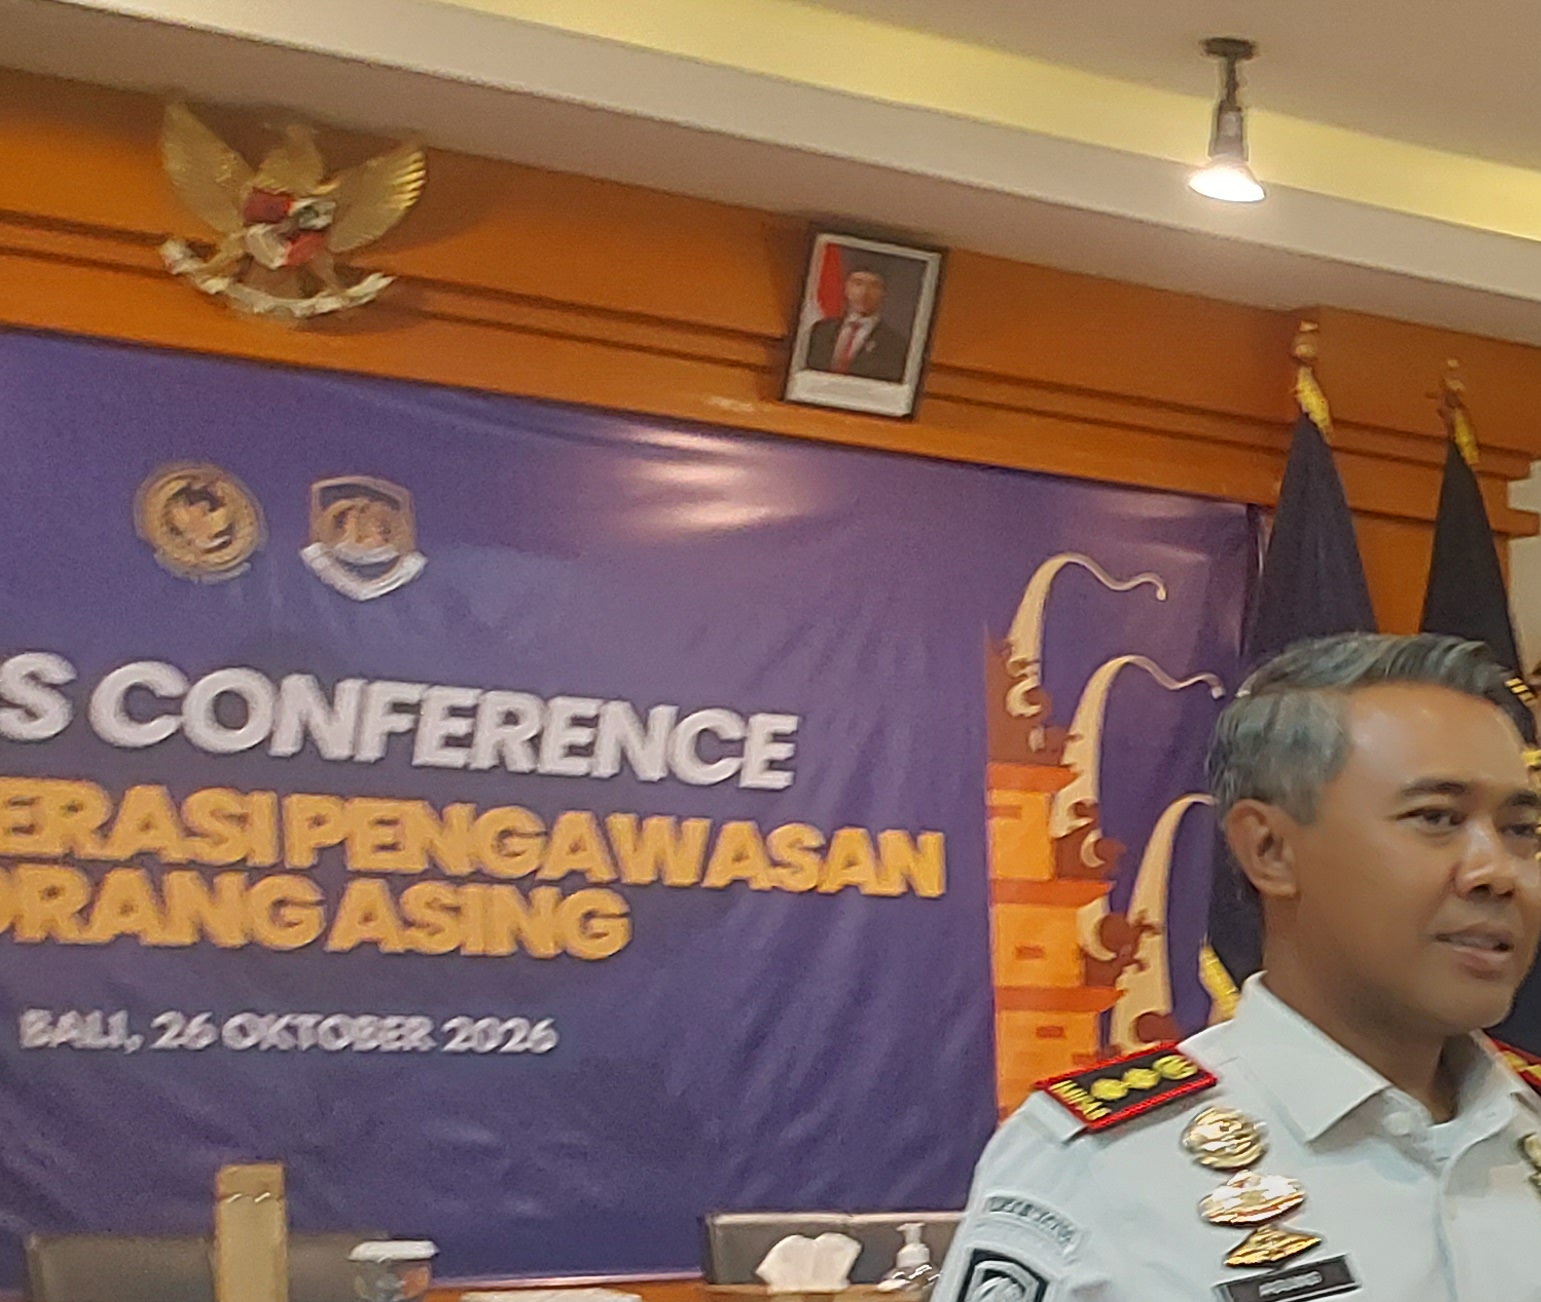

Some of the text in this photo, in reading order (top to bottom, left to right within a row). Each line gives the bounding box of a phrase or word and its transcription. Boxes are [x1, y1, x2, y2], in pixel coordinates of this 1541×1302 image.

[0, 651, 800, 790] S CONFERENCE
[283, 792, 947, 898] PENGAWASAN
[0, 863, 633, 960] RANG ASING
[19, 1008, 145, 1054] BALI,
[150, 1010, 218, 1051] 26
[221, 1012, 438, 1052] OKTOBER
